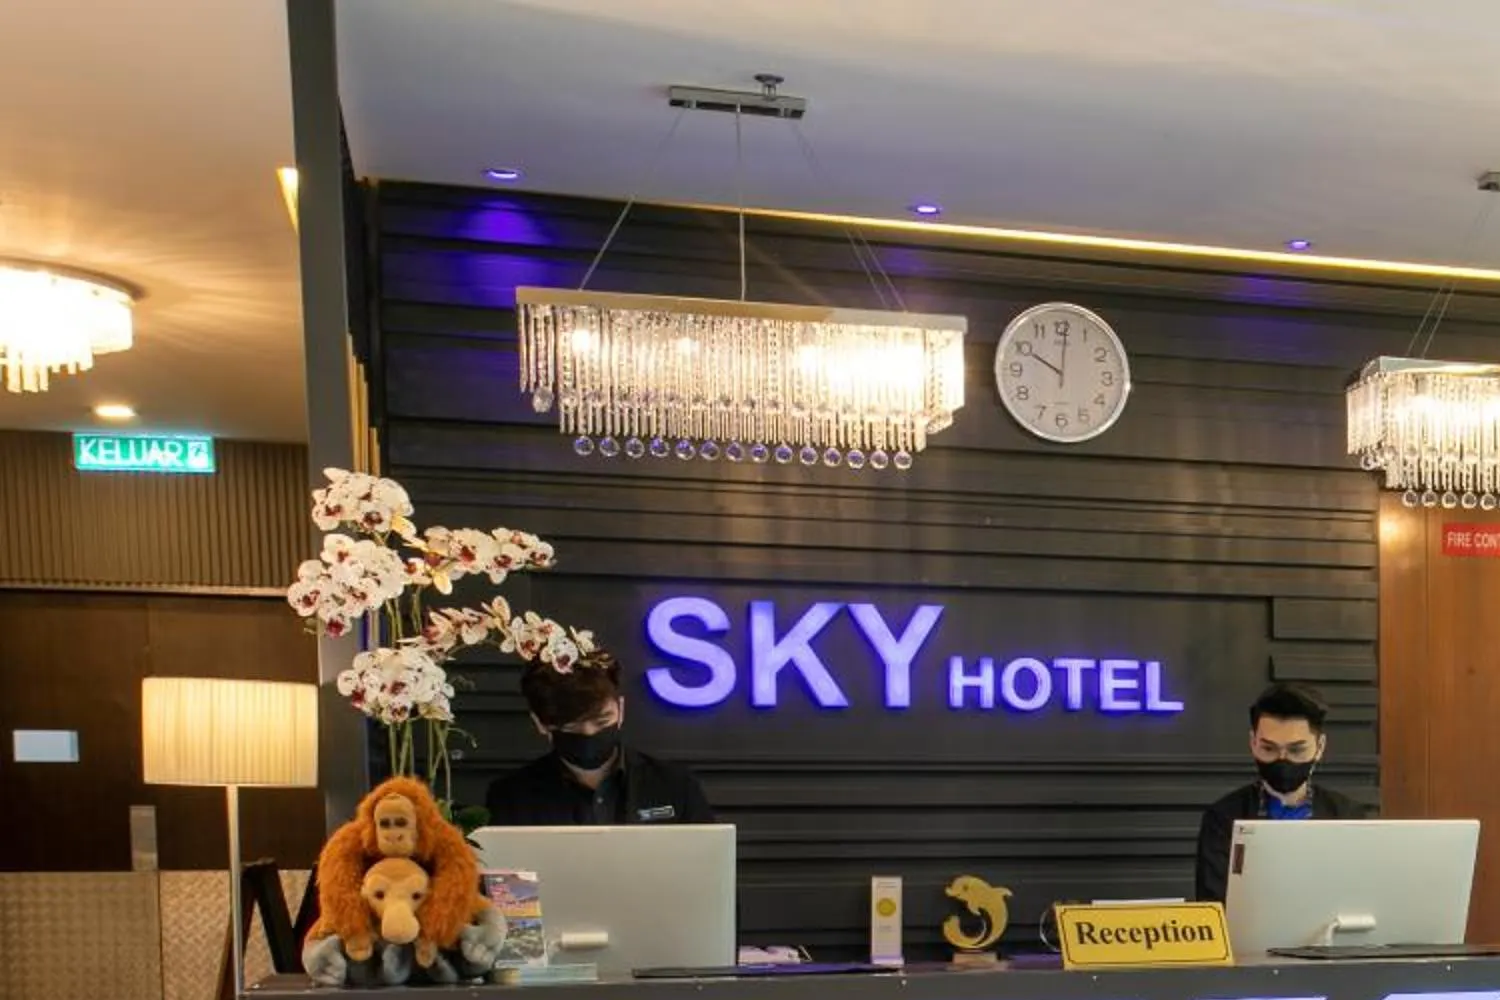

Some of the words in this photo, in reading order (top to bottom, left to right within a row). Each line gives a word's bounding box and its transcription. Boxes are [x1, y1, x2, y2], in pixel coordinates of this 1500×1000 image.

[1093, 346, 1108, 363] 2
[1009, 361, 1023, 378] 9
[1101, 370, 1113, 387] 3
[1016, 385, 1029, 401] 8
[79, 438, 184, 468] KELUAR
[1447, 531, 1473, 548] FIRE
[645, 596, 945, 708] SKY
[949, 655, 1185, 712] HOTEL
[1075, 919, 1215, 950] Reception
